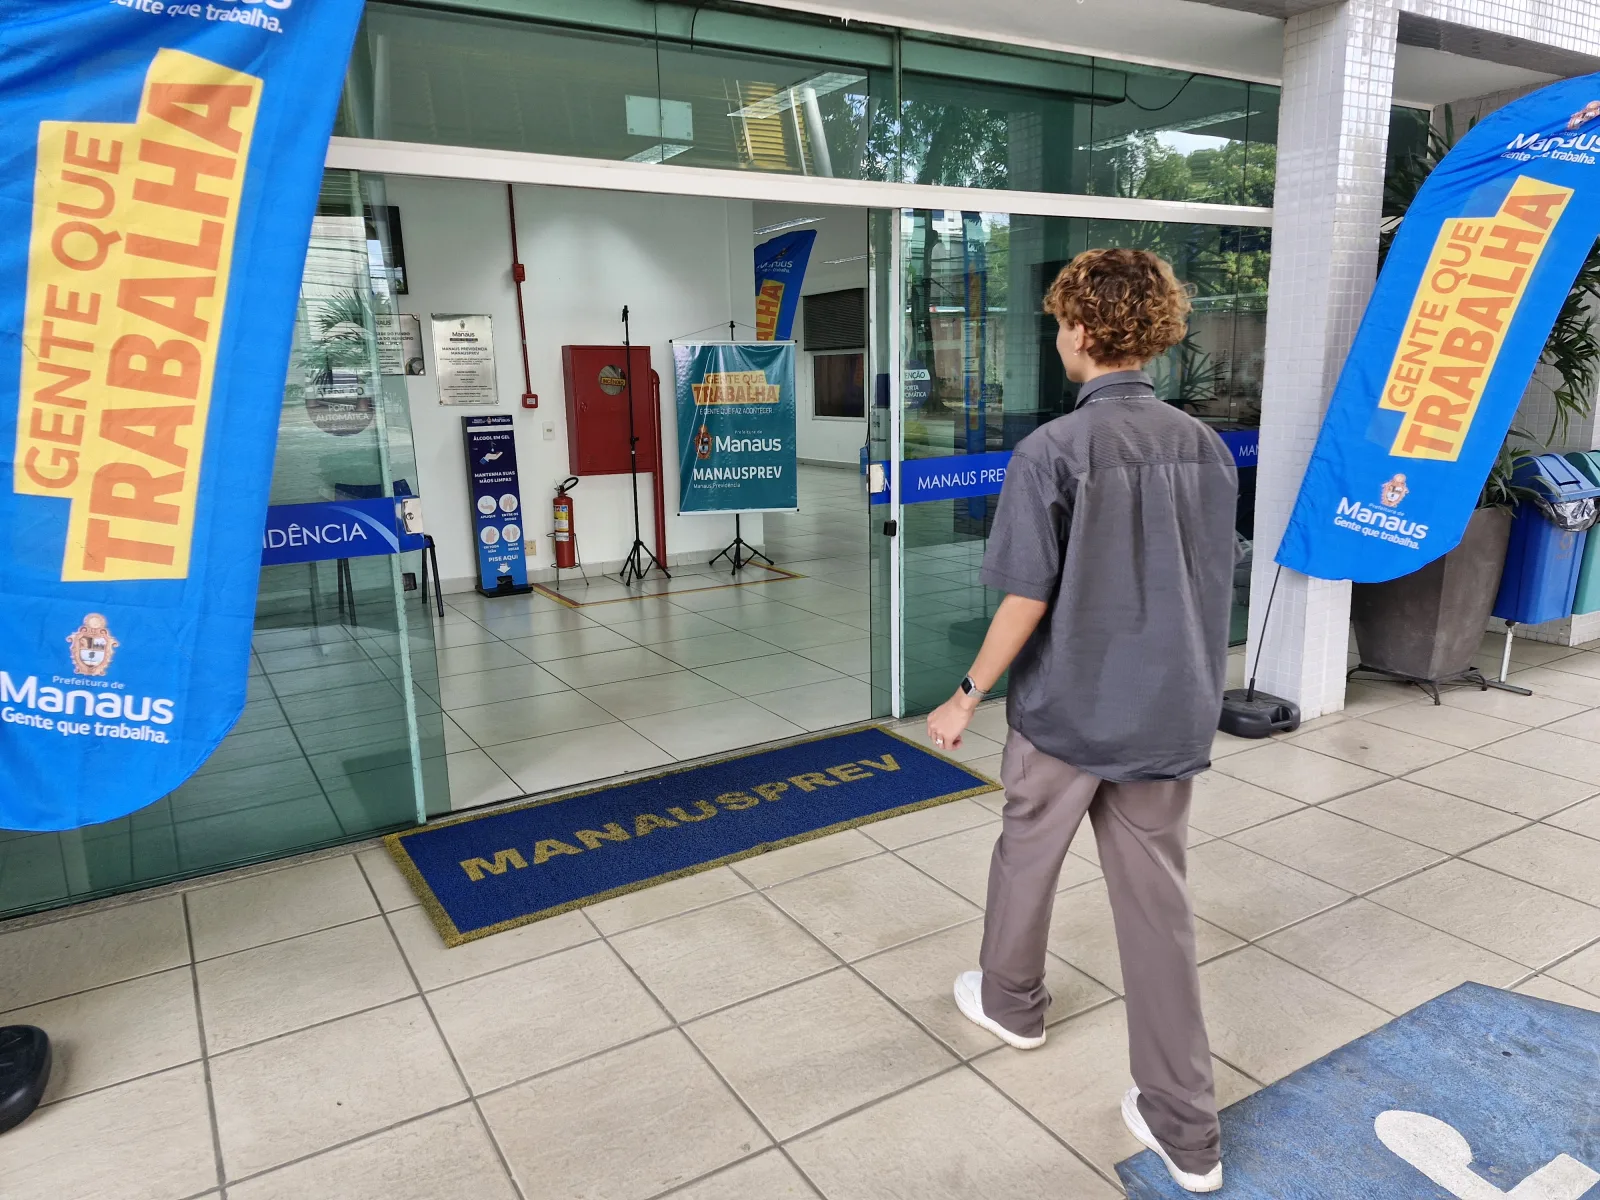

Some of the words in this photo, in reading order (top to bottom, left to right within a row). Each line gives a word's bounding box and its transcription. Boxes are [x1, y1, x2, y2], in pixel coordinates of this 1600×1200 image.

[167, 4, 200, 17] que
[206, 4, 283, 33] trabalha.
[1551, 149, 1596, 165] trabalha.
[51, 130, 124, 271] QUE
[82, 82, 254, 573] TRABALHA
[1387, 301, 1449, 407] GENTE
[1431, 222, 1485, 294] QUE
[1401, 192, 1568, 454] TRABALHA
[24, 284, 102, 488] GENTE
[693, 385, 778, 403] TRABALHA
[706, 374, 740, 384] GENTE
[742, 373, 765, 385] QUE
[715, 436, 782, 452] Manaus
[693, 466, 782, 481] MANAUSPREV
[917, 470, 977, 490] MANAUS
[1336, 497, 1429, 540] Manaus
[1368, 502, 1397, 514] Prefeitura
[1334, 516, 1362, 532] Gente
[1362, 526, 1380, 537] que
[1380, 531, 1420, 550] trabalha.
[0, 671, 175, 725] Manaus
[52, 675, 109, 689] Prefeitura
[110, 681, 126, 690] de
[1, 706, 55, 730] Gente
[56, 719, 92, 737] que
[94, 722, 171, 745] trabalha.
[459, 753, 902, 882] MANAUSPREV
